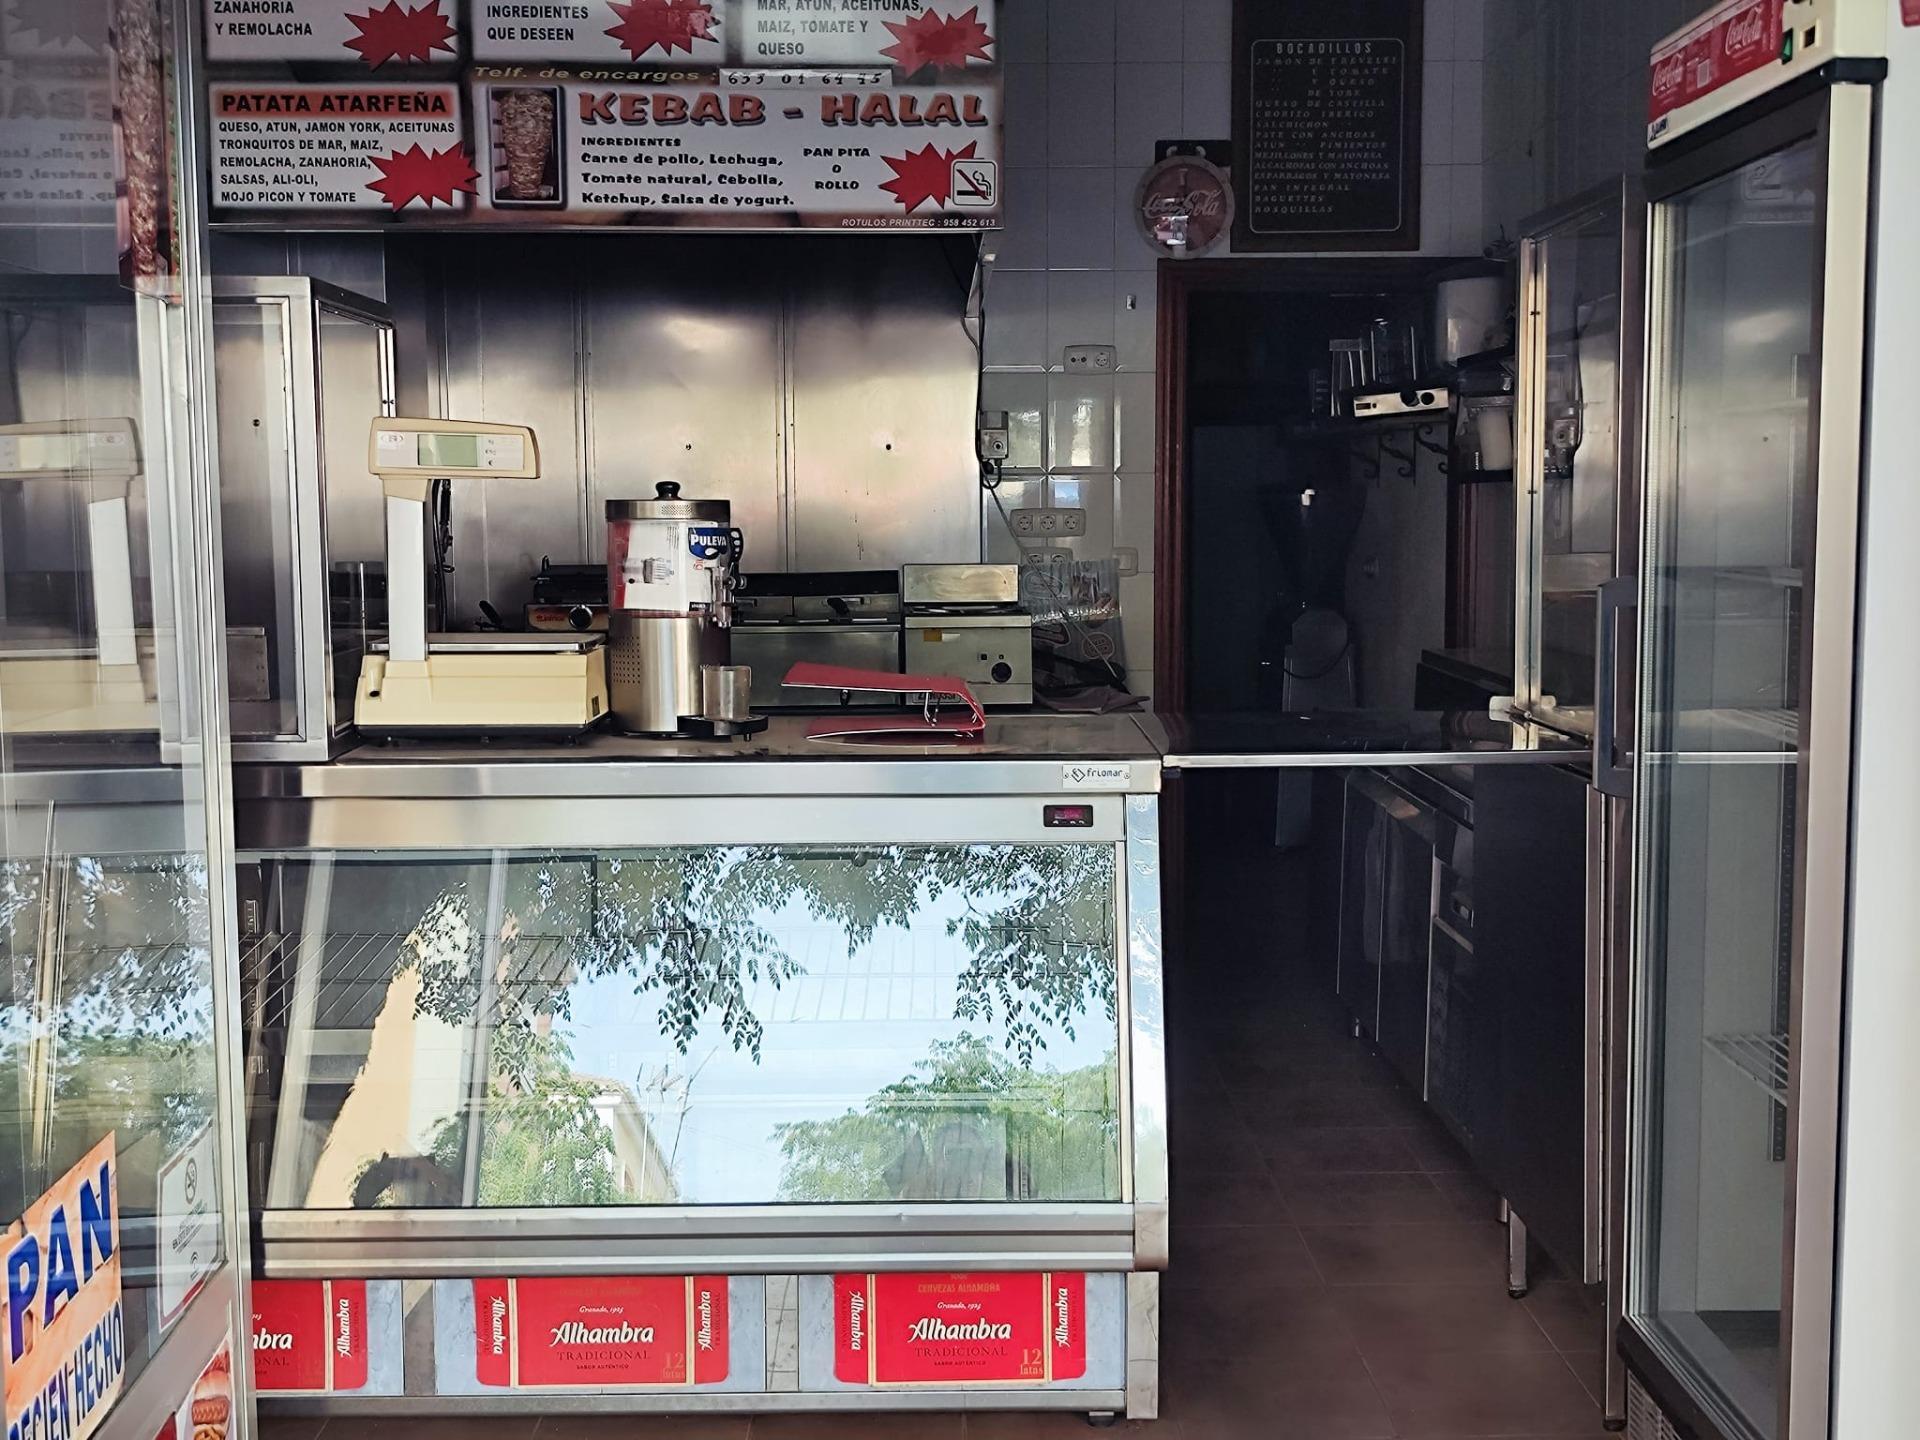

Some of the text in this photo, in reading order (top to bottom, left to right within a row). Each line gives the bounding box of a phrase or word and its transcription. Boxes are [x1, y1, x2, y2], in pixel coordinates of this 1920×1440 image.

[214, 1, 294, 14] ZANAHORIA
[487, 5, 589, 20] INGREDIENTES
[841, 0, 923, 13] ACEITUNAS,
[215, 23, 312, 36] Y REMOLACHA
[487, 27, 574, 40] QUE DESEEN
[757, 20, 868, 35] MAIZ, TOMATE Y
[758, 43, 804, 55] QUESO
[1276, 42, 1372, 54] BOCADILLOS
[475, 66, 528, 79] Telf.
[539, 67, 572, 79] de
[579, 69, 699, 83] encargos
[223, 92, 447, 112] PATATA ATARFEÑA
[578, 91, 766, 126] KEBAB
[821, 92, 988, 126] HALAL
[219, 122, 455, 134] QUESO, ATUN, JAMON YORK, ACEITUNAS
[219, 140, 382, 152] TRONQUITOS DE MAR, MAIZ,
[581, 137, 681, 146] INGREDIENTES
[803, 148, 870, 156] PAN PITA
[220, 156, 371, 169] REMOLACHA, ZANAHORIA,
[581, 152, 784, 166] Carne de pollo, Lechuga,
[832, 164, 842, 174] O
[220, 174, 318, 186] SALSAS, ALI-OLI,
[581, 172, 784, 186] Tomate natural, Cebolla,
[814, 180, 860, 190] ROLLO
[221, 192, 356, 202] MOJO PICON Y TOMATE
[582, 192, 794, 207] Ketchup, Salsa de yogurt.
[842, 218, 887, 226] ROTULOS
[889, 218, 936, 226] PRINTTEC
[943, 218, 959, 226] 958
[962, 218, 978, 226] 452
[980, 218, 996, 226] 613
[690, 534, 727, 546] PULEVA
[7, 1160, 114, 1364] PAN
[490, 1295, 504, 1354] Alhambra
[698, 1290, 714, 1351] Alhambra
[849, 1290, 862, 1350] Alhambra
[1055, 1288, 1070, 1348] Alhambra
[336, 1298, 352, 1358] Alhambra
[550, 1320, 654, 1347] Alhambra
[907, 1318, 1012, 1343] Alhambra
[556, 1350, 651, 1361] TRADICIONAL
[914, 1346, 1008, 1357] TRADICIONAL
[1022, 1348, 1042, 1364] 12
[8, 1300, 123, 1440] ECIEN HECHO
